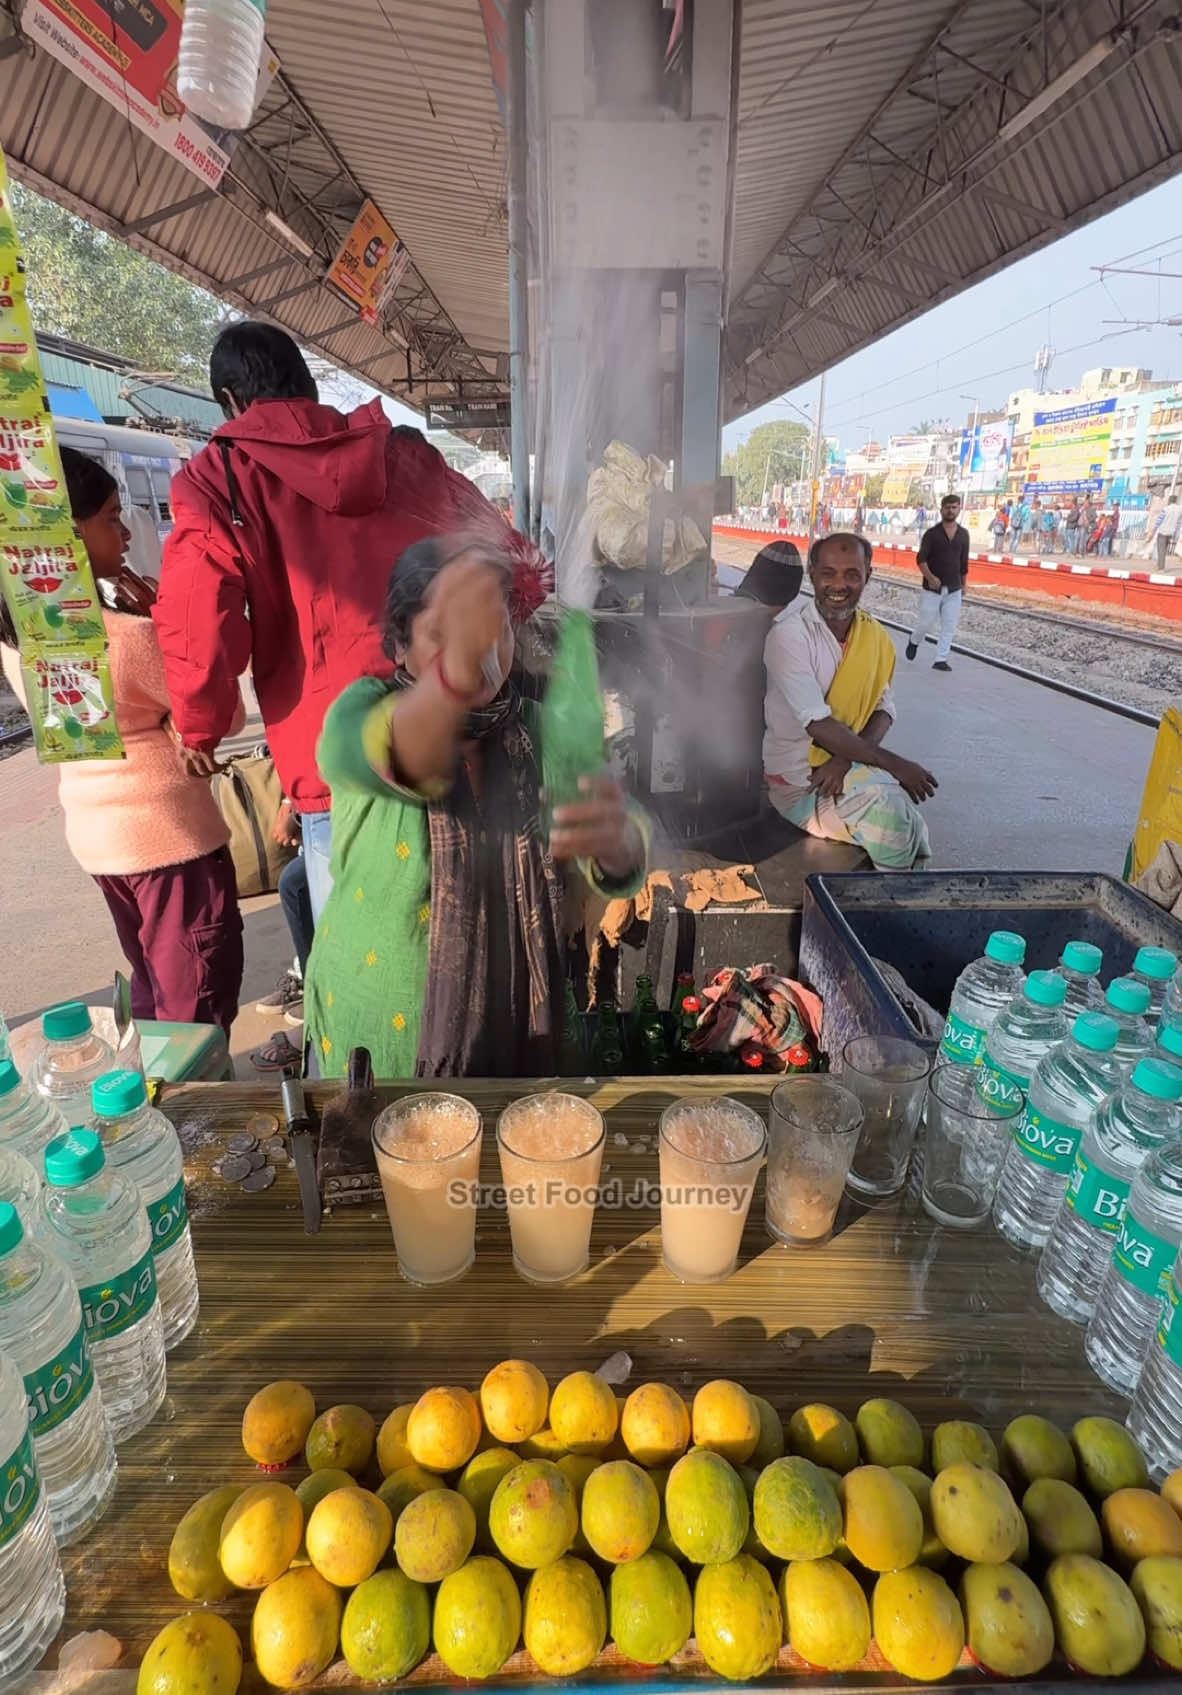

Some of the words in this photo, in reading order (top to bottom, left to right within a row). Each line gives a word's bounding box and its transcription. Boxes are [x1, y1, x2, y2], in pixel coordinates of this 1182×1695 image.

[33, 12, 51, 34] Visit
[174, 132, 195, 159] 1800
[3, 543, 76, 559] Natraj
[37, 673, 100, 690] Jalji
